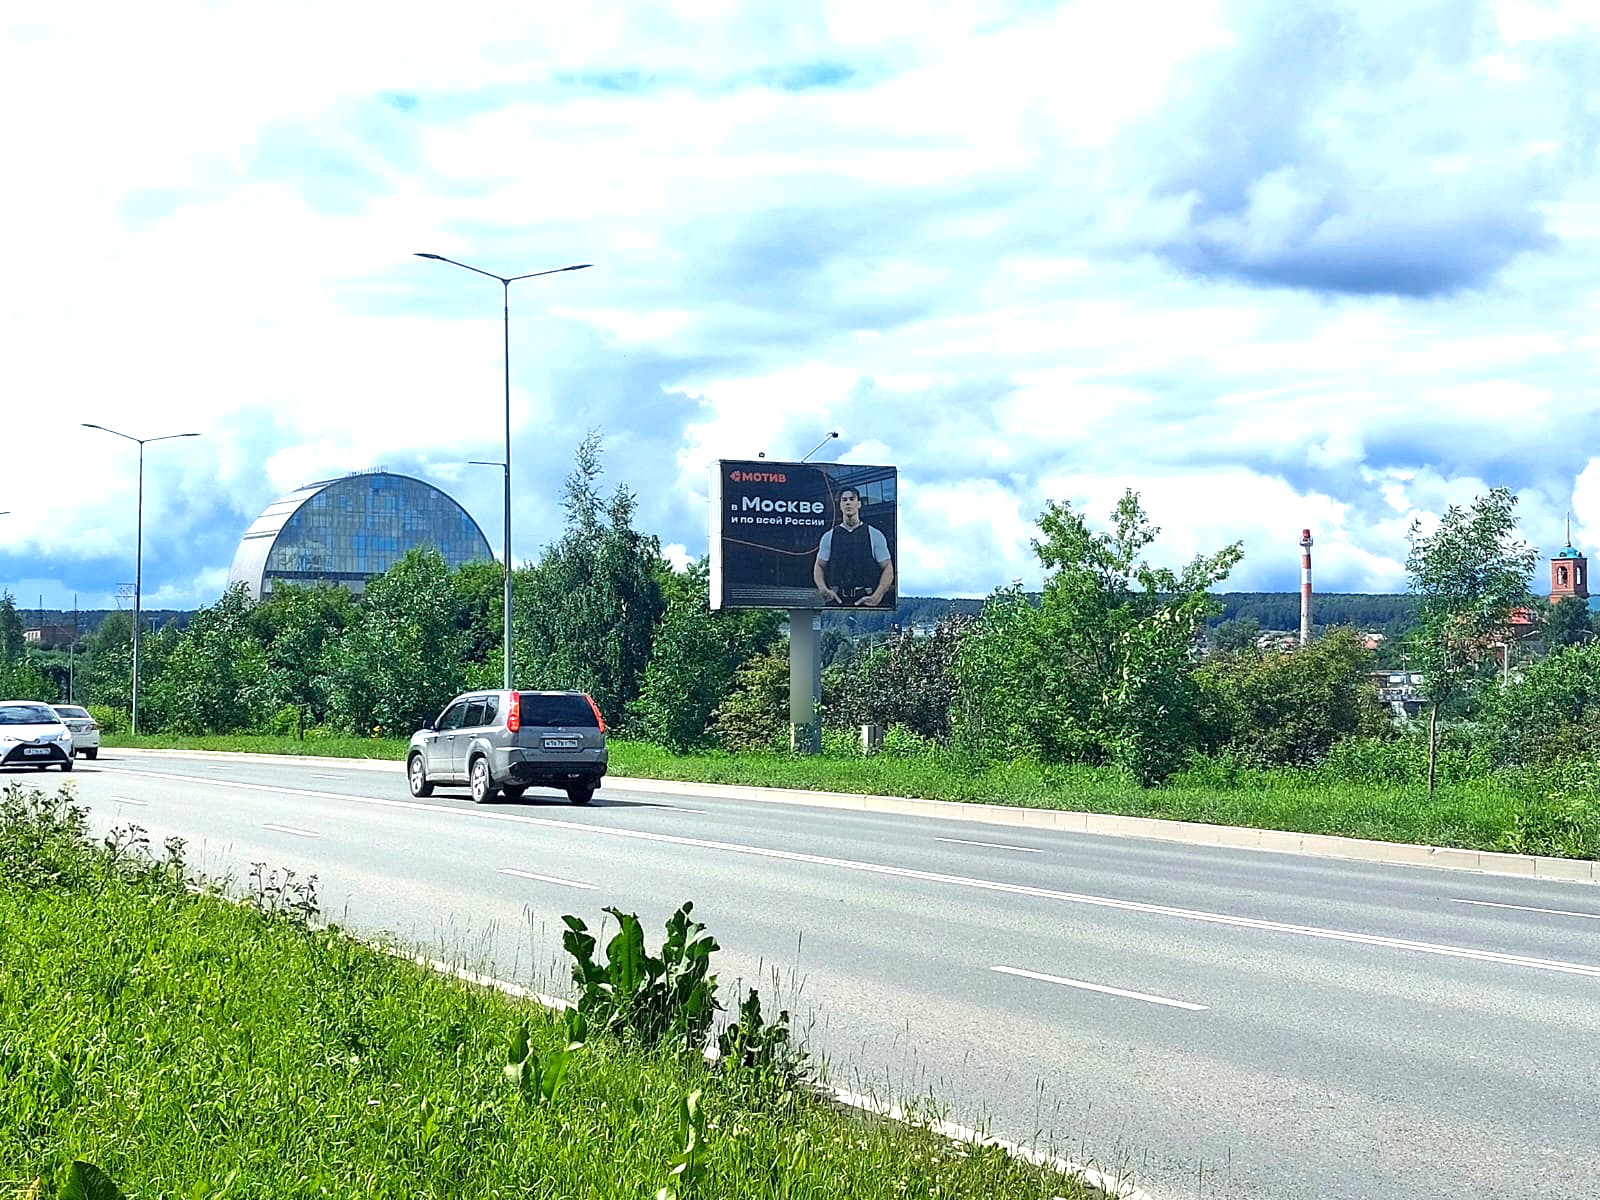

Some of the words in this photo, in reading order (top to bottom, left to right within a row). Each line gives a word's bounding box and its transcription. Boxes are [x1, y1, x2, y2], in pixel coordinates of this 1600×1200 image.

[742, 472, 786, 483] МОТИВ
[731, 503, 738, 511] в
[742, 496, 825, 514] Москве
[731, 516, 738, 524] и
[740, 516, 754, 524] по
[756, 516, 783, 524] всей
[784, 516, 825, 527] России
